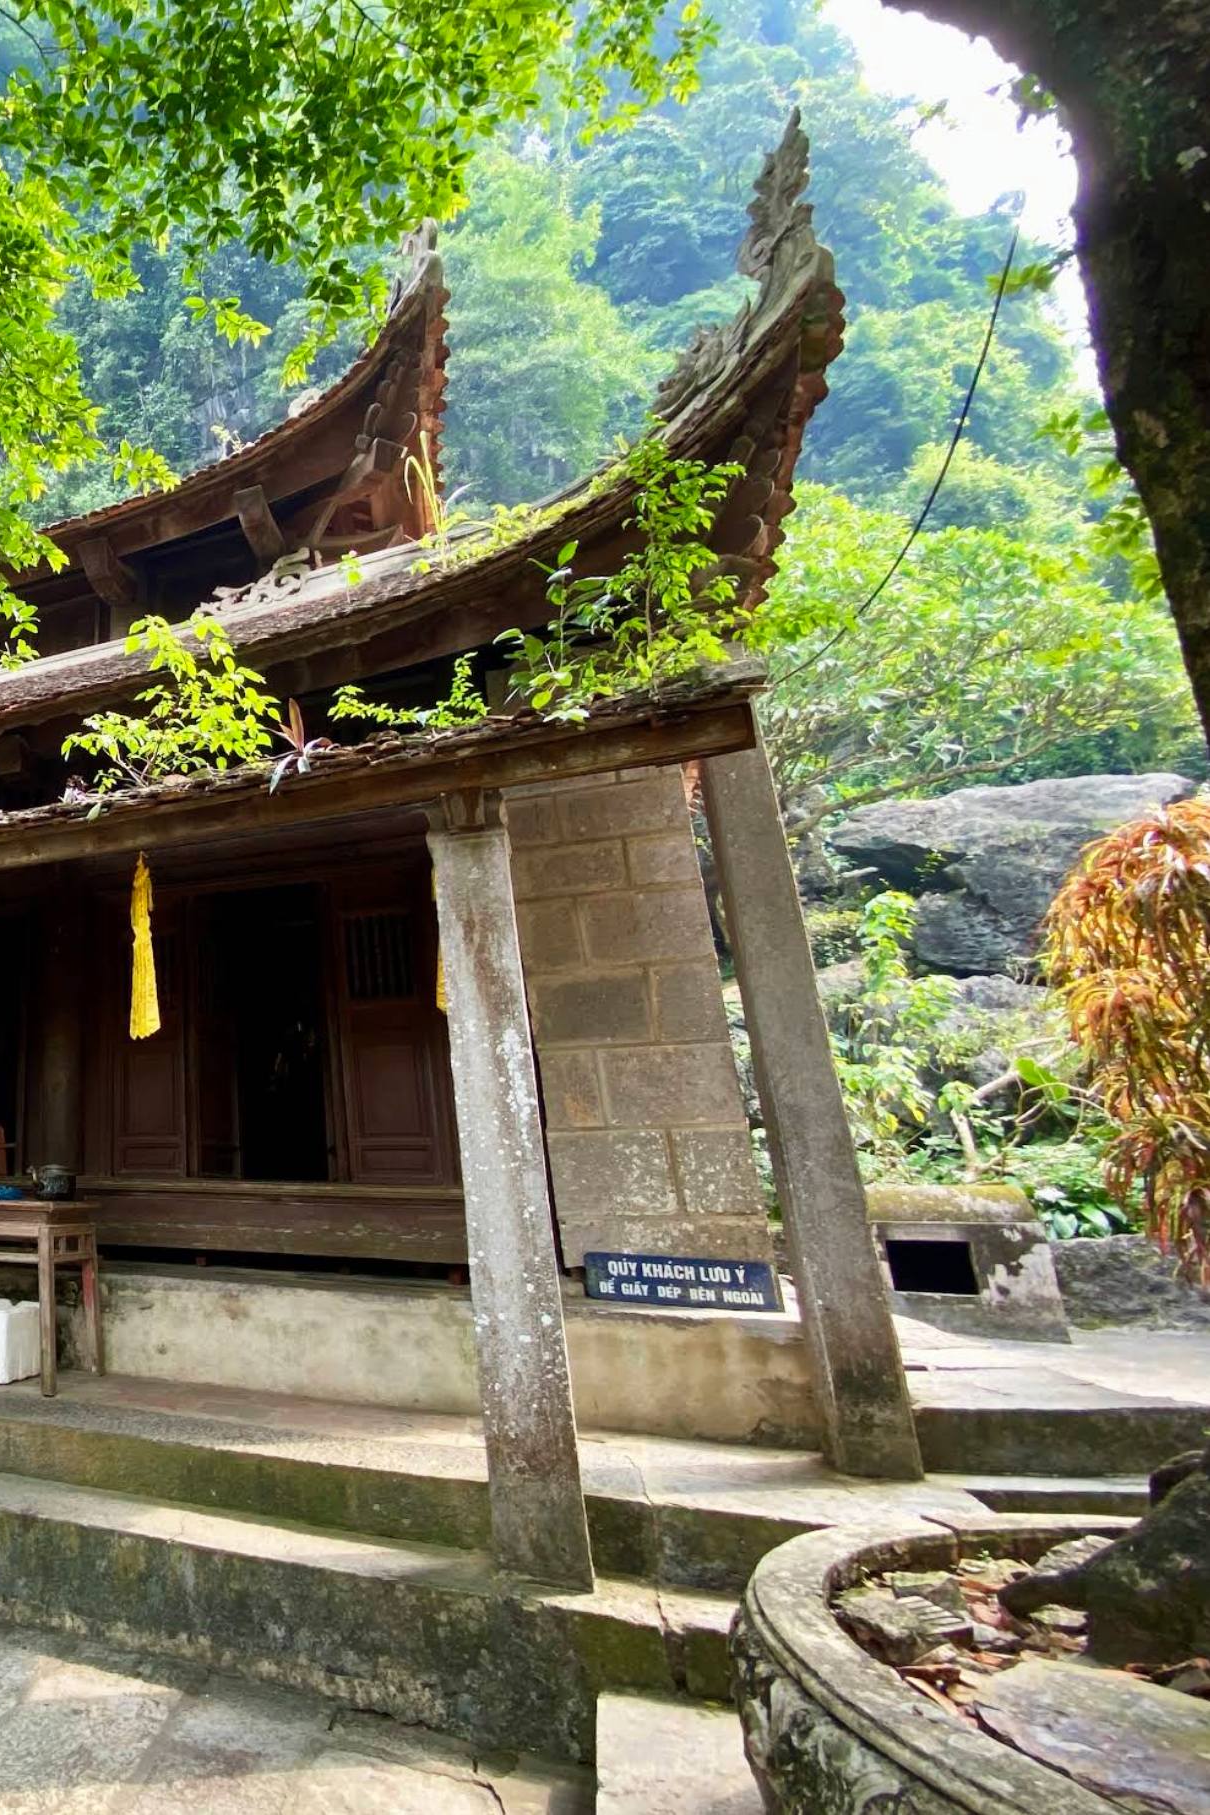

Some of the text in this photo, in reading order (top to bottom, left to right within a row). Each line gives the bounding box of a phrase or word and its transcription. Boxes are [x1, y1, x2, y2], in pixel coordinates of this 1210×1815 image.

[642, 1260, 695, 1280] KHÁCH
[699, 1265, 731, 1283] LƯU
[735, 1265, 746, 1284] Ý
[689, 1286, 716, 1302] BÊN
[722, 1288, 765, 1305] NGOÀI
